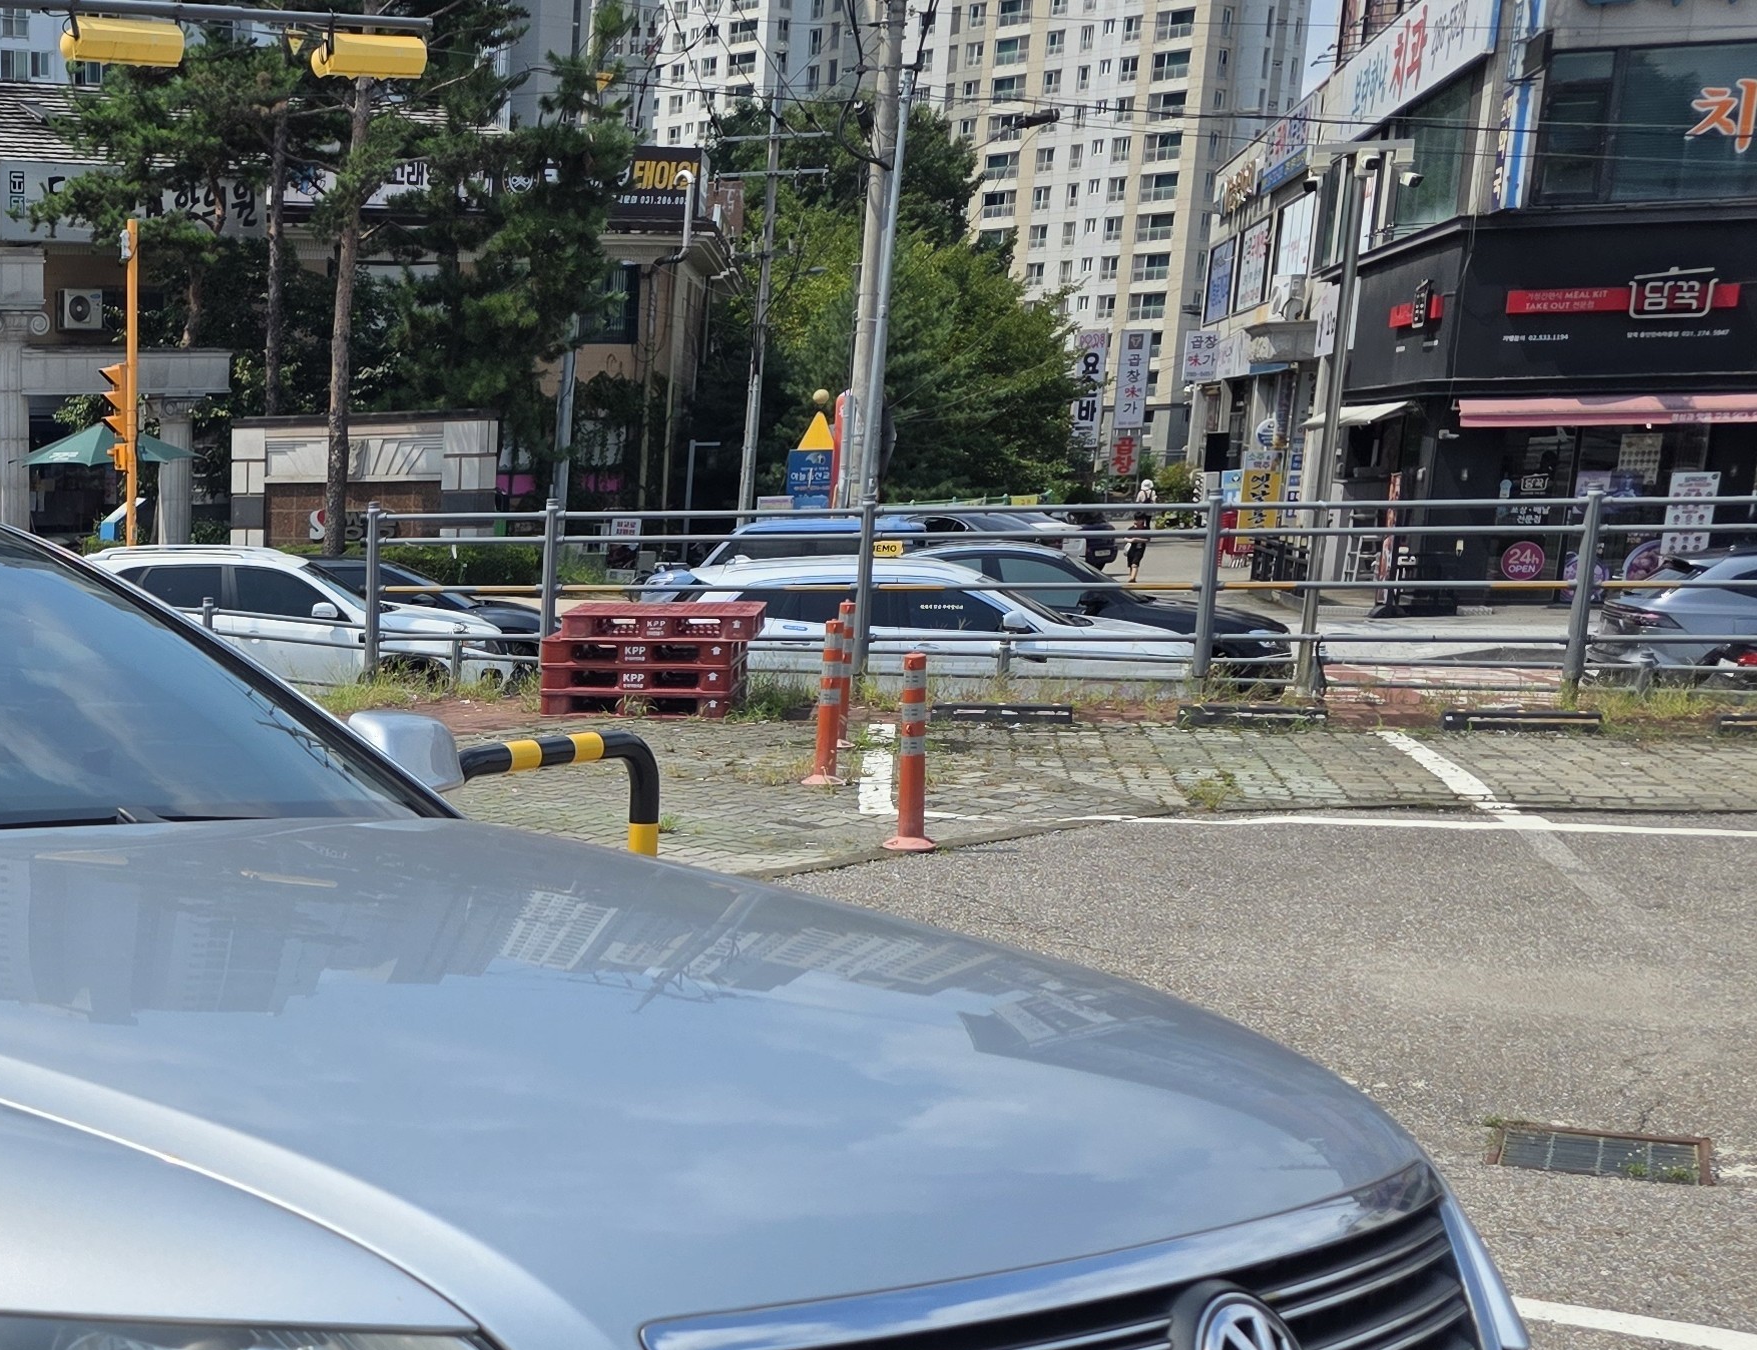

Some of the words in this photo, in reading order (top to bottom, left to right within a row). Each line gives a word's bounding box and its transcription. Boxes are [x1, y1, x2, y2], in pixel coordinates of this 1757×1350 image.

[1564, 290, 1591, 300] MEAL
[1592, 289, 1609, 299] KIT
[1525, 302, 1549, 311] TAKE
[1550, 301, 1571, 310] OUT
[1190, 334, 1219, 350] 곱창
[1111, 436, 1137, 474] 곱창
[1508, 549, 1539, 565] 24h
[1508, 563, 1536, 574] OPEN
[646, 620, 666, 628] KPP
[624, 646, 646, 655] KPP
[622, 673, 645, 682] KPP
